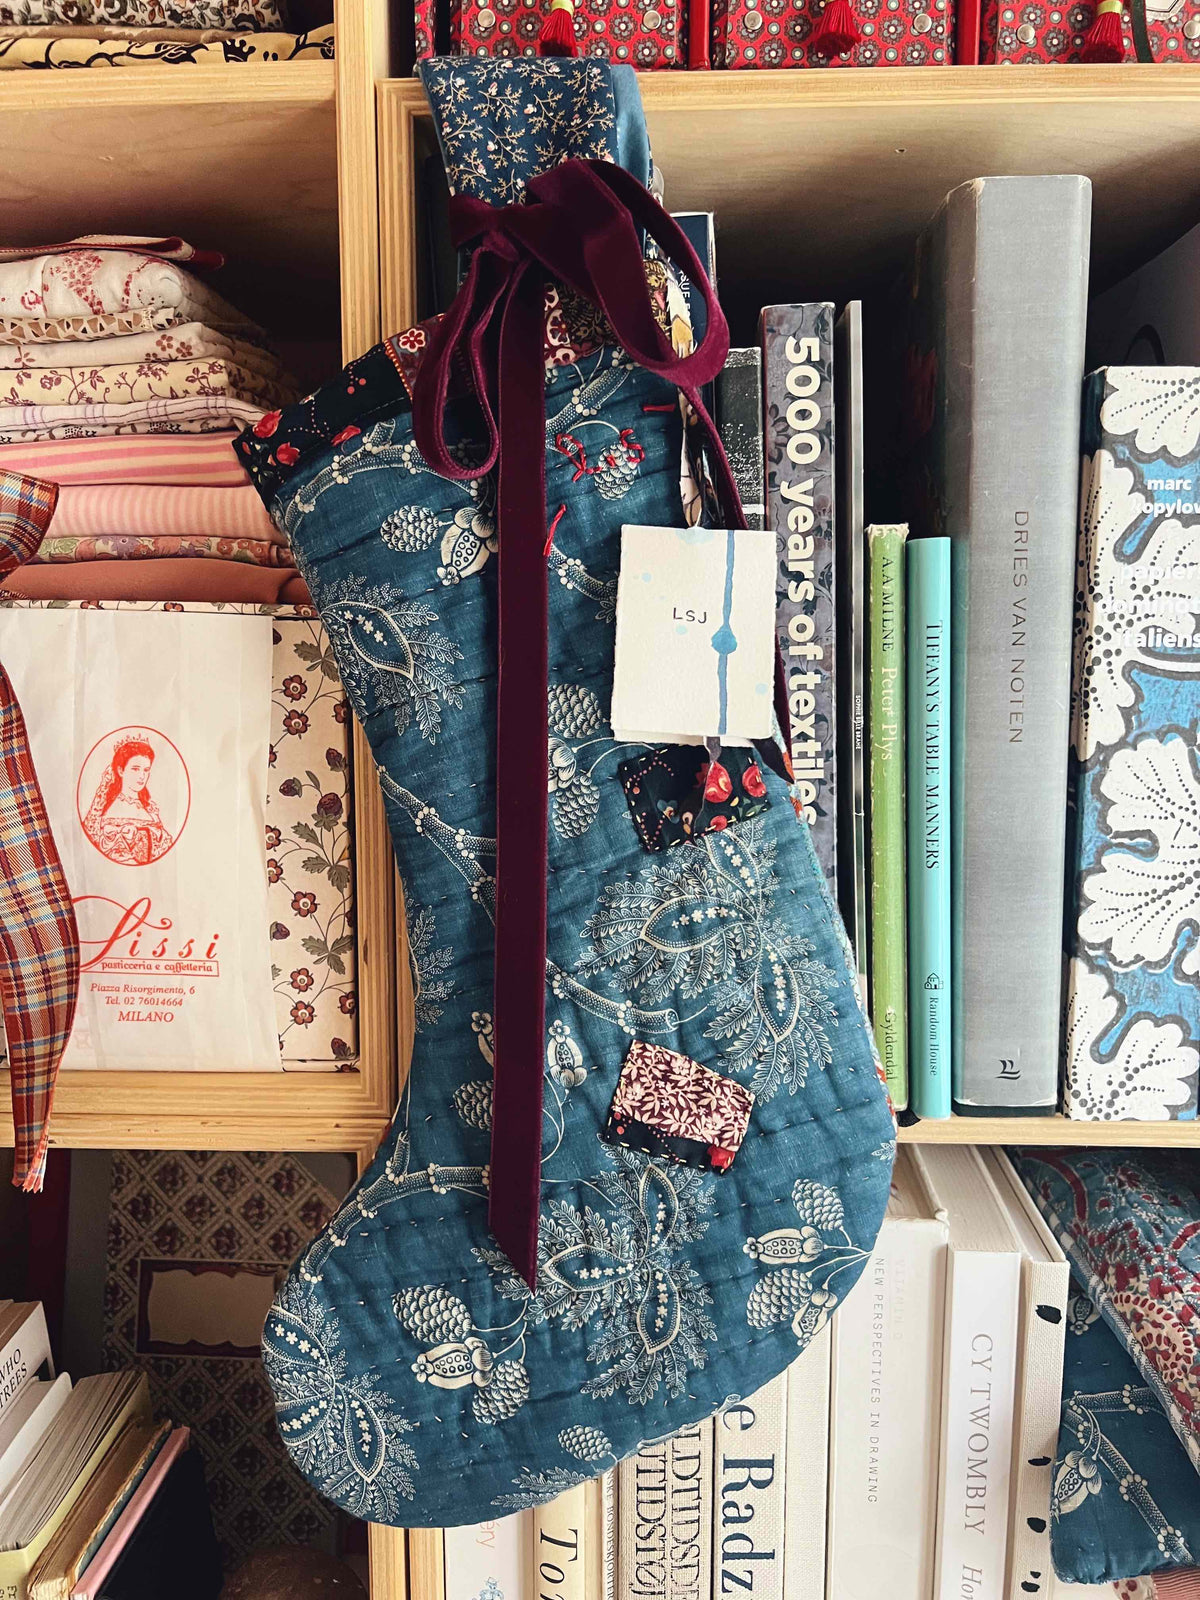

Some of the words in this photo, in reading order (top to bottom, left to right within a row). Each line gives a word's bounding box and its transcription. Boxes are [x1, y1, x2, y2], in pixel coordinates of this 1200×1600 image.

[785, 336, 821, 465] 5000
[1147, 479, 1192, 490] marc
[779, 478, 815, 603] years
[1013, 511, 1029, 587] DRIES
[673, 607, 707, 624] LSJ
[788, 614, 824, 660] of
[1012, 597, 1027, 646] VAN
[925, 620, 943, 713] TIFFANY'S
[1009, 658, 1025, 743] NOTEN
[874, 723, 898, 760] Plys
[925, 719, 939, 776] TABLE
[925, 784, 939, 869] MANNERS
[90, 983, 120, 993] Piazza
[123, 984, 186, 995] Risorgimento,
[189, 986, 195, 995] 6
[101, 960, 152, 971] pasticceria
[155, 963, 160, 971] e
[164, 963, 213, 974] caffetteria
[105, 996, 120, 1005] Tel.
[124, 997, 135, 1005] 02
[139, 997, 183, 1007] 76014664
[118, 1011, 174, 1022] MILANO
[929, 997, 940, 1041] Random
[879, 1012, 897, 1080] Gyldendal
[929, 1044, 940, 1076] House
[874, 1258, 885, 1286] NEW
[870, 1294, 884, 1403] PERSPECTIVES
[971, 1333, 994, 1372] CY
[870, 1411, 879, 1428] IN
[867, 1436, 879, 1503] DRAWING
[964, 1382, 991, 1535] TWOMBLY
